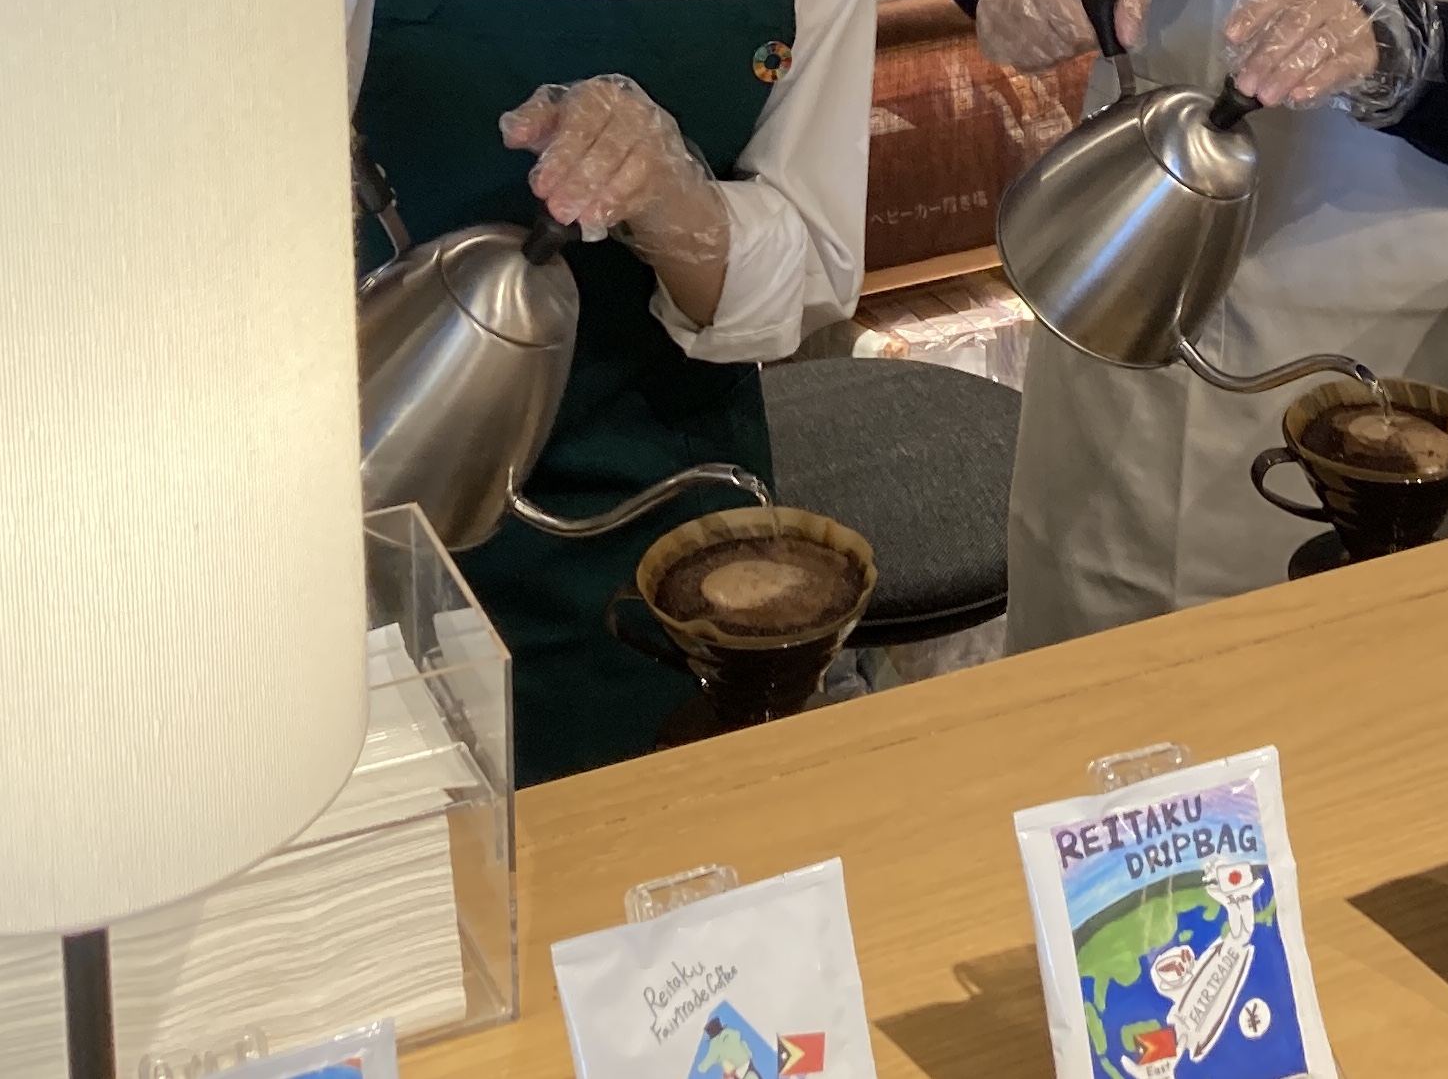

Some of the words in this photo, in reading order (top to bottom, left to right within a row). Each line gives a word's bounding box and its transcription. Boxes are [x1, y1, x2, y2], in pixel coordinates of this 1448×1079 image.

[1055, 793, 1203, 869] REITAKU
[1125, 824, 1258, 879] DRIPBAG
[1189, 946, 1240, 1028] FAIRTRADE
